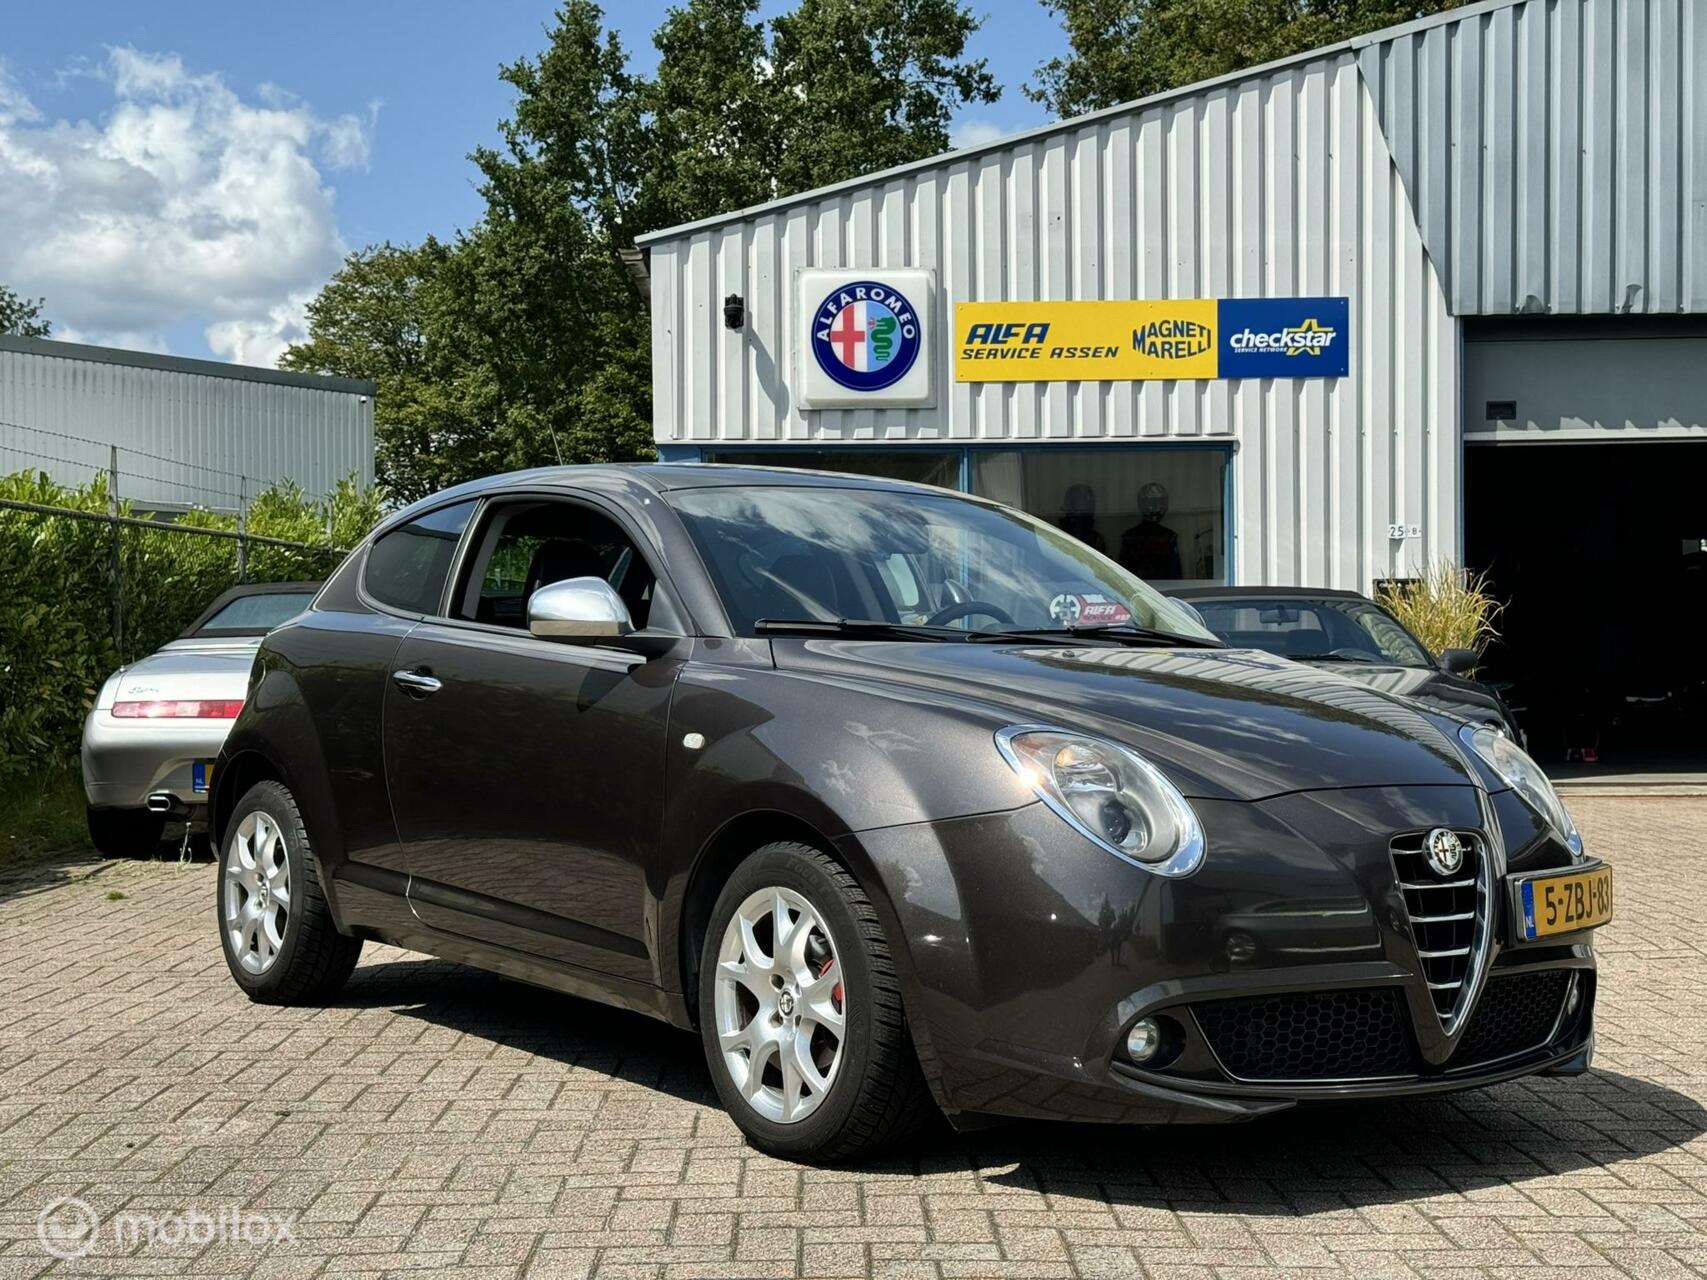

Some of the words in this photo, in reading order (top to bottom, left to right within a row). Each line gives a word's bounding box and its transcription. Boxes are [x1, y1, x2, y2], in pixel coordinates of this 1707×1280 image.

[965, 323, 1050, 345] ALFA
[1229, 328, 1337, 348] checkstar
[960, 347, 1043, 360] SERVICE
[1049, 346, 1119, 358] ASSEN
[1545, 875, 1610, 926] 5-ZBJ-83
[1525, 915, 1535, 928] NL
